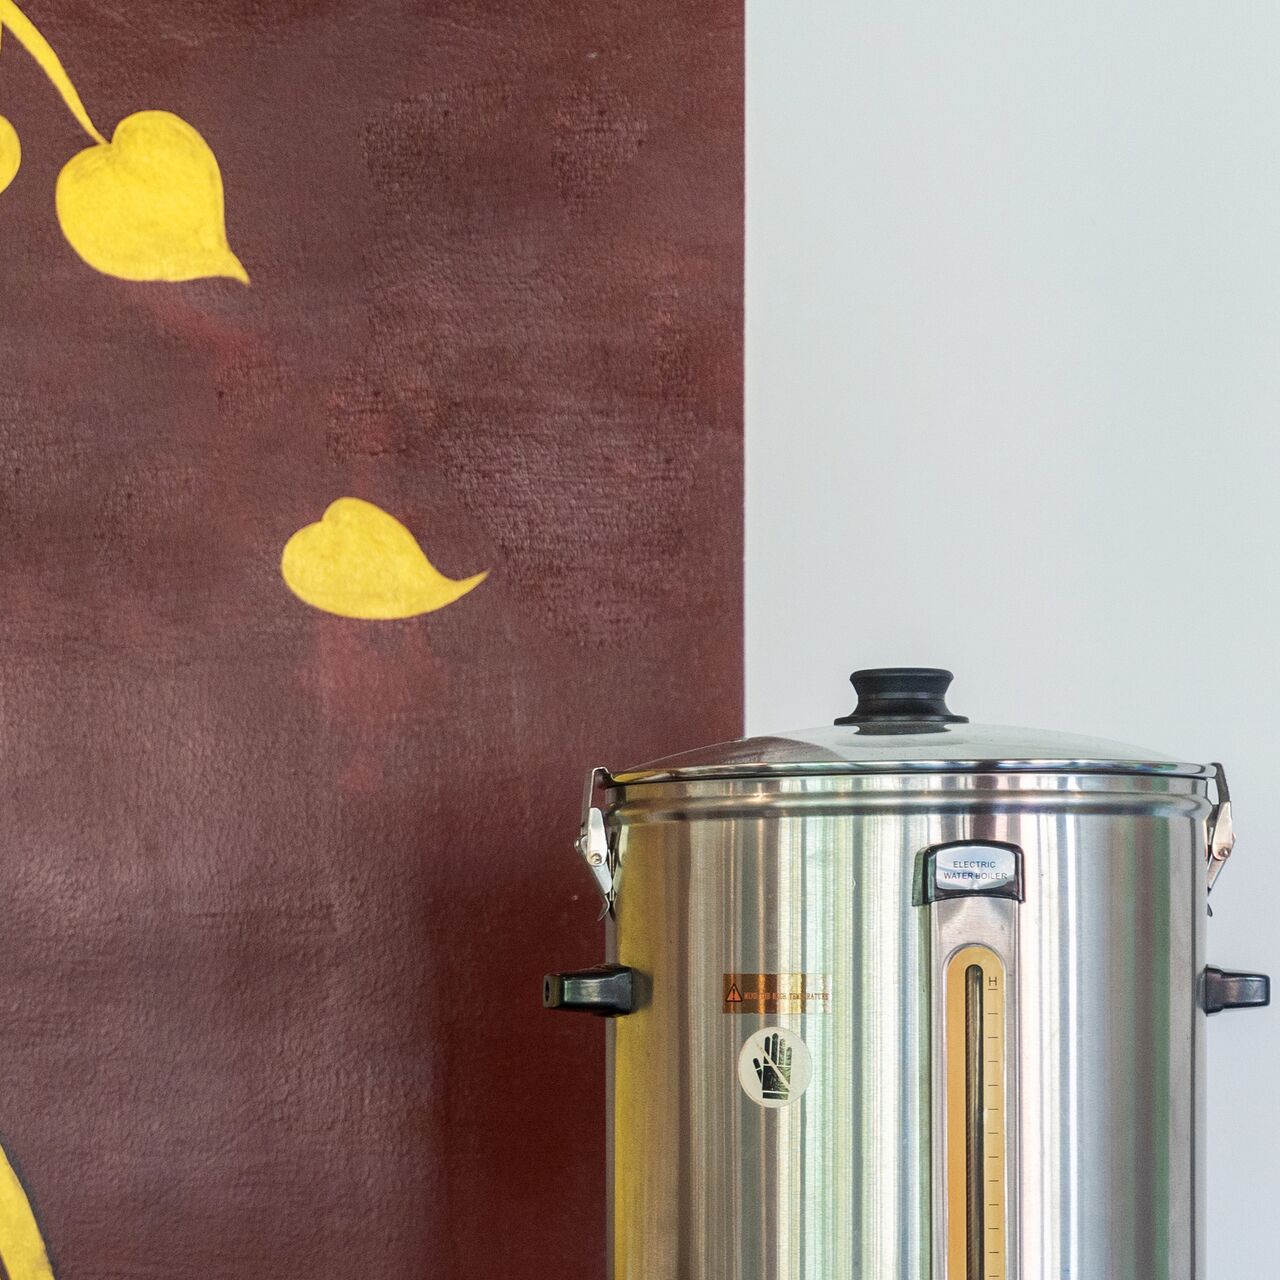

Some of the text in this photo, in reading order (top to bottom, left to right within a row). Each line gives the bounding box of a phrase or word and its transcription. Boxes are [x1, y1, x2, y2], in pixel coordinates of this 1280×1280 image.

[953, 860, 996, 869] ELECTRIC
[943, 872, 1008, 880] WATER BOILER
[988, 976, 998, 986] H
[789, 992, 829, 1000] TEMRATURE
